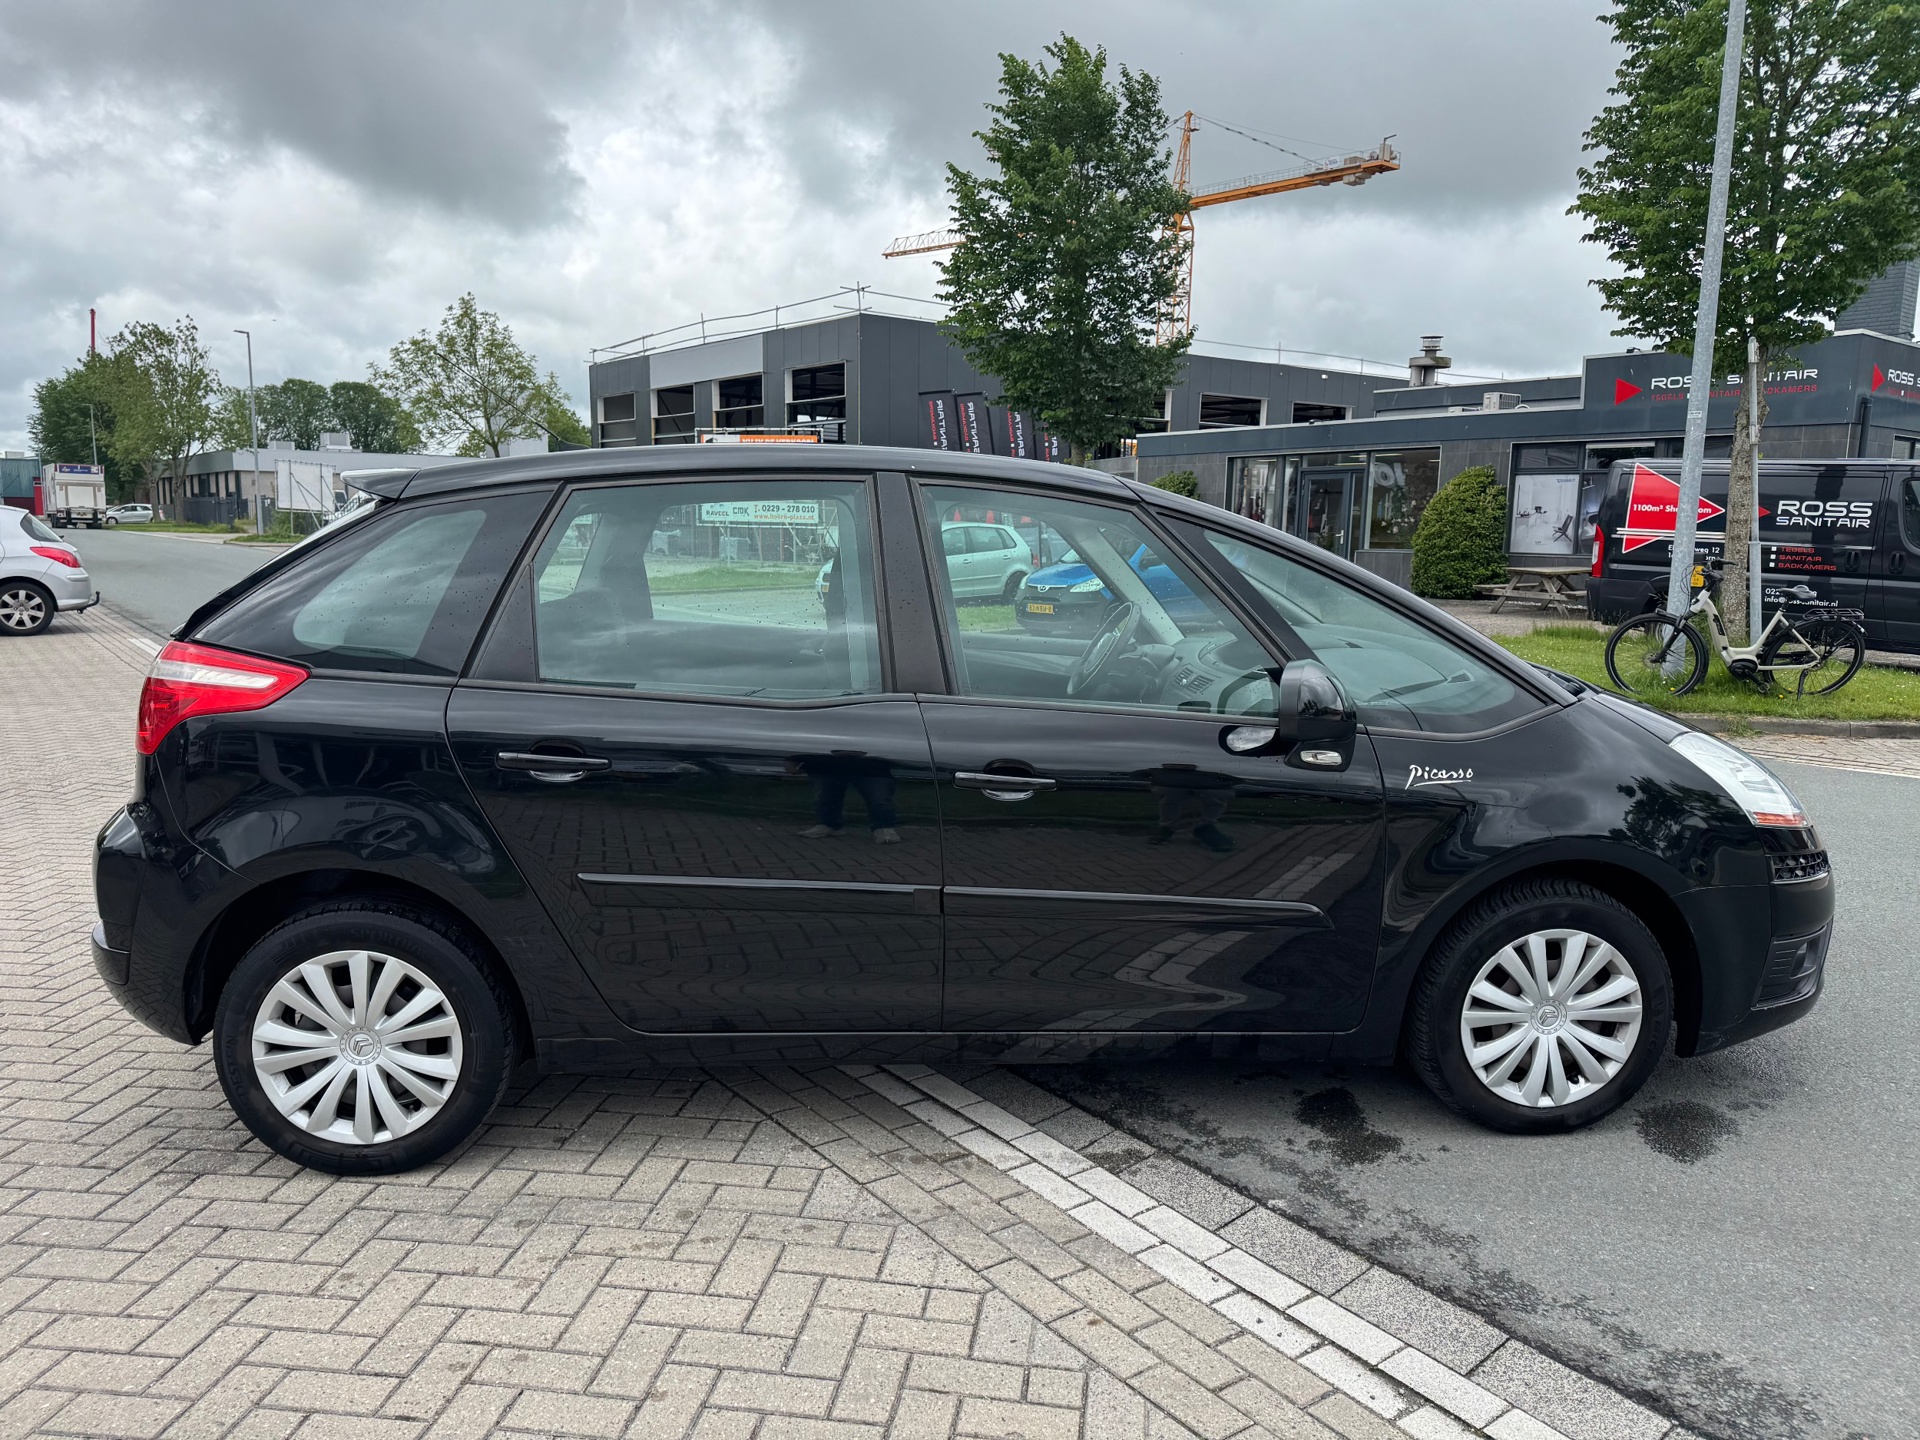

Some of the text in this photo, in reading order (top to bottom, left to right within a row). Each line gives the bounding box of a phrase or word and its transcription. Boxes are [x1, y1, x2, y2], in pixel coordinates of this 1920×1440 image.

[1650, 375, 1715, 390] ROS
[1887, 368, 1915, 386] ROSS
[1763, 384, 1818, 396] DKAMERS
[762, 504, 780, 512] 0229
[787, 505, 800, 513] 278
[801, 505, 816, 513] 010
[1777, 500, 1874, 518] ROSS
[1776, 516, 1871, 529] SANITAIR
[1712, 546, 1720, 554] 12
[1779, 554, 1822, 562] SANITAIR
[1778, 562, 1837, 571] BADKAMERS
[1404, 764, 1474, 790] Picasso
